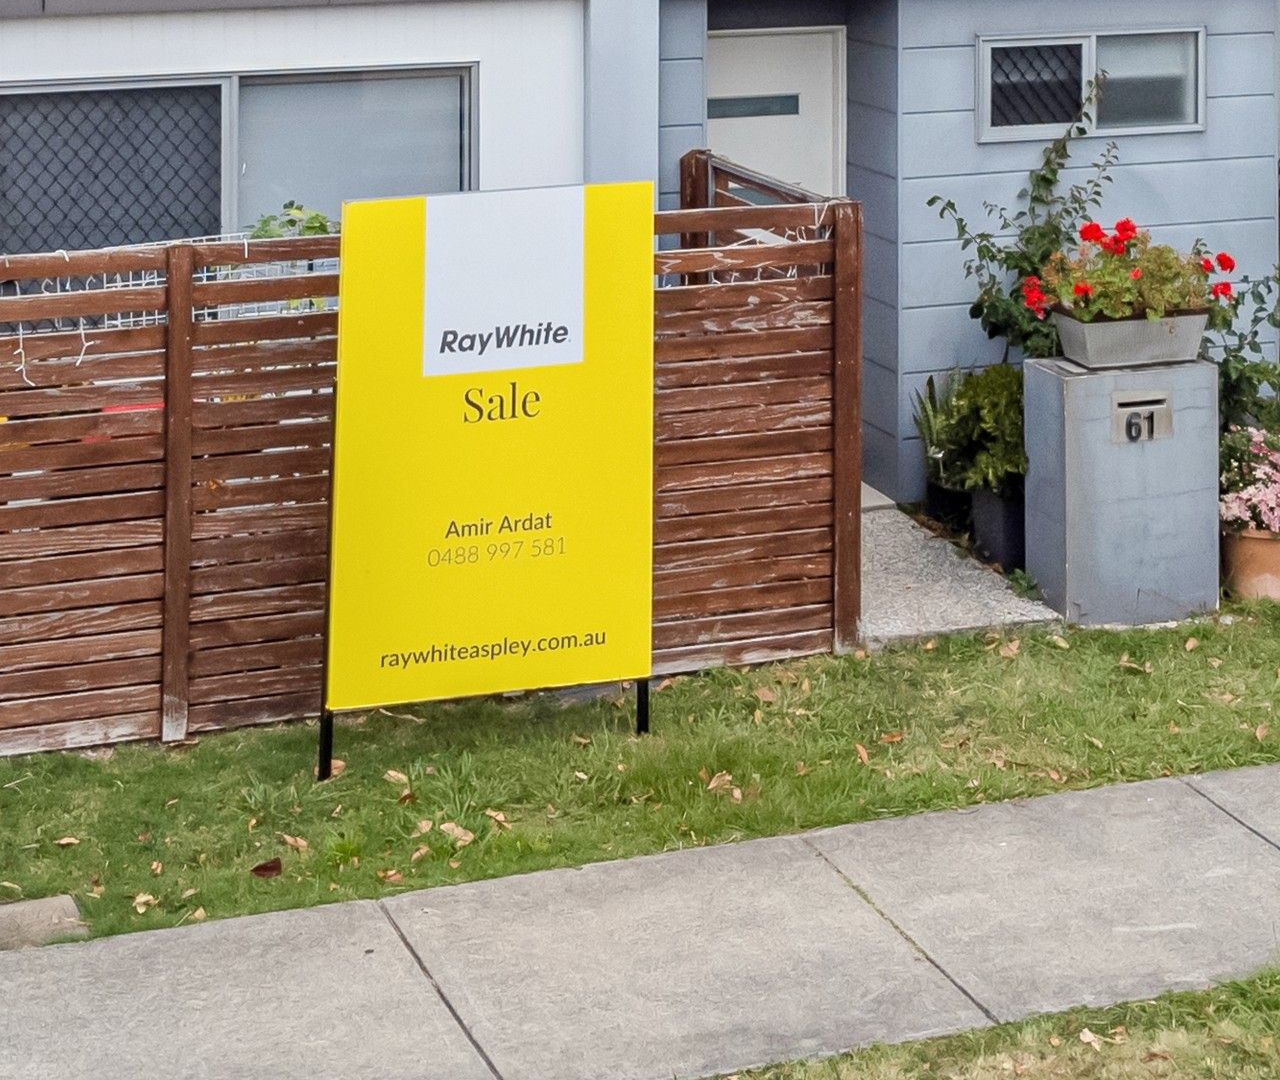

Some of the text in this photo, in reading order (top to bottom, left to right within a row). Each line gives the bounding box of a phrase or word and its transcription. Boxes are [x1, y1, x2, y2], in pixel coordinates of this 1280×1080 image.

[463, 381, 541, 424] Sale
[1125, 410, 1155, 442] 61
[444, 512, 553, 539] Amir Ardat
[427, 536, 567, 567] 0488 997 581
[380, 631, 606, 669] raywhiteaspley.com.au
